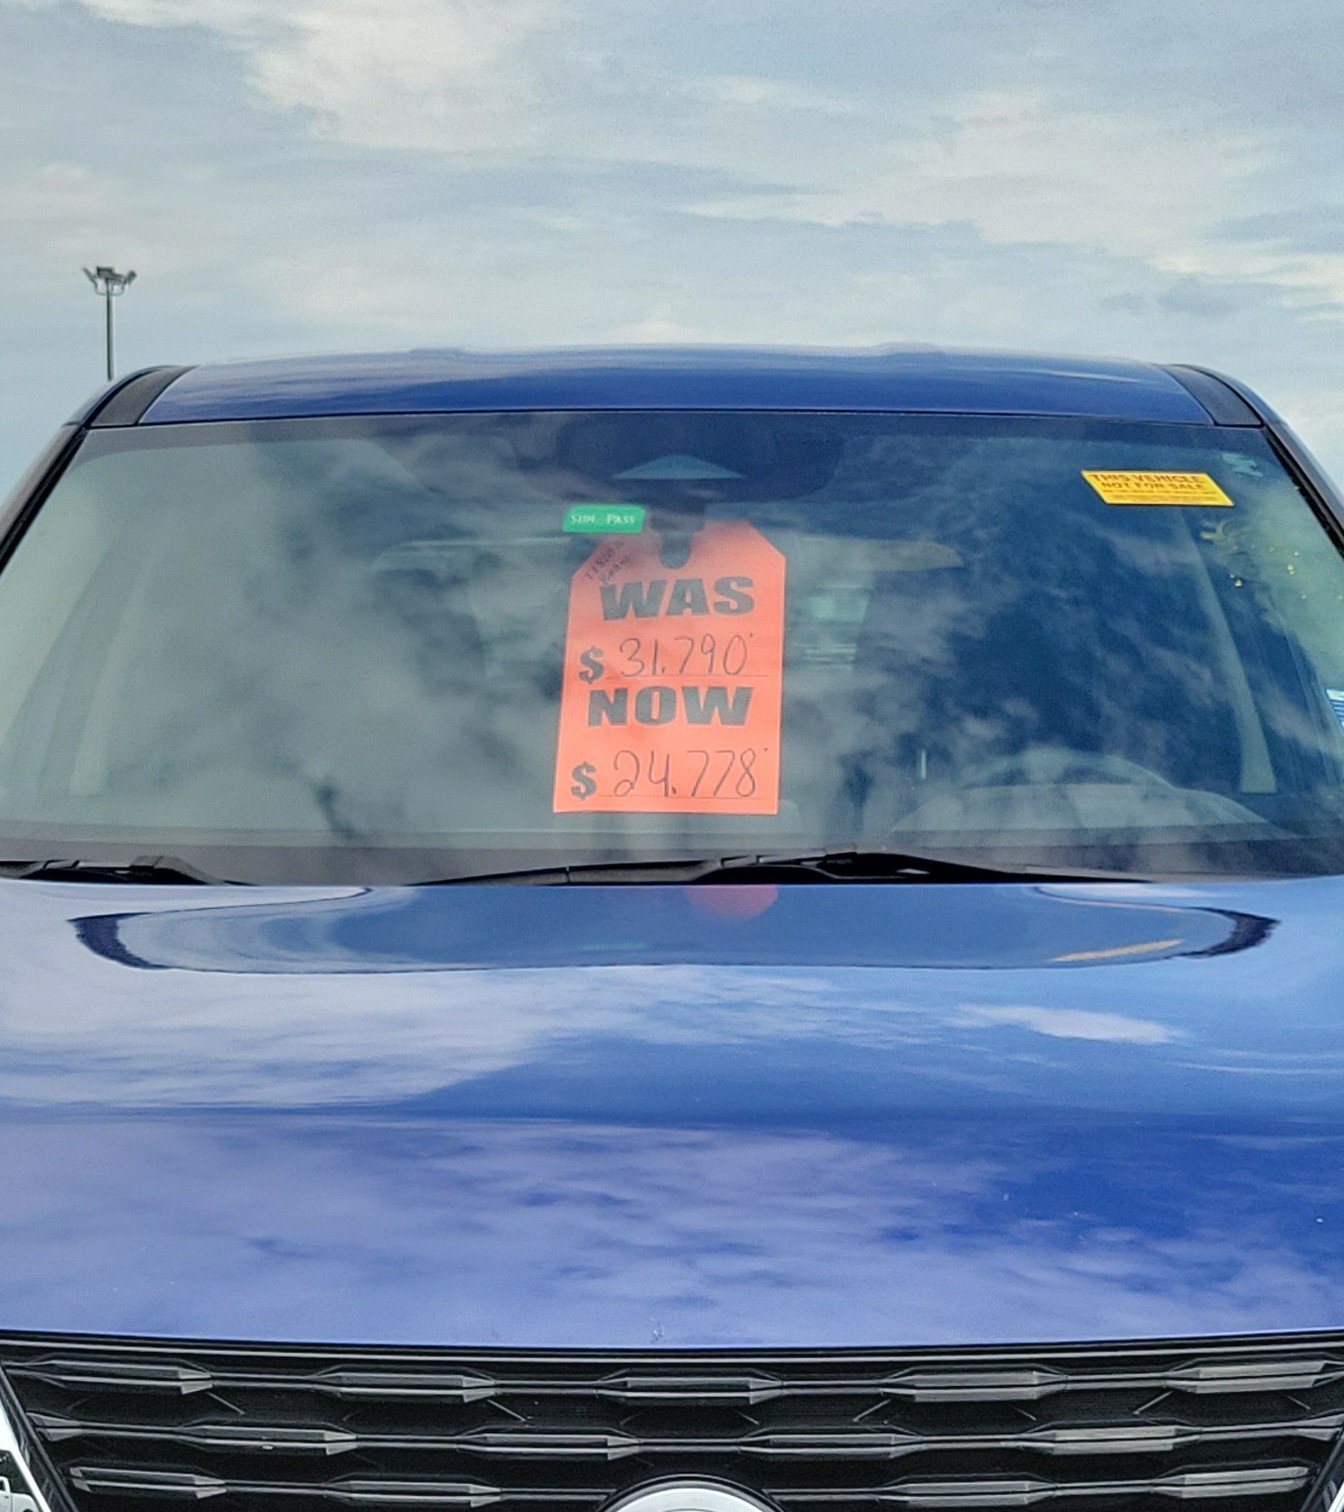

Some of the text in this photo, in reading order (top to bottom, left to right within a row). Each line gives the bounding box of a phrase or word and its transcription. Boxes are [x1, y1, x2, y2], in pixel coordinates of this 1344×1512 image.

[1133, 474, 1205, 483] VEHICLE
[600, 576, 755, 621] WAS
[578, 646, 605, 684] $
[587, 685, 754, 727] NOW
[570, 761, 597, 800] $
